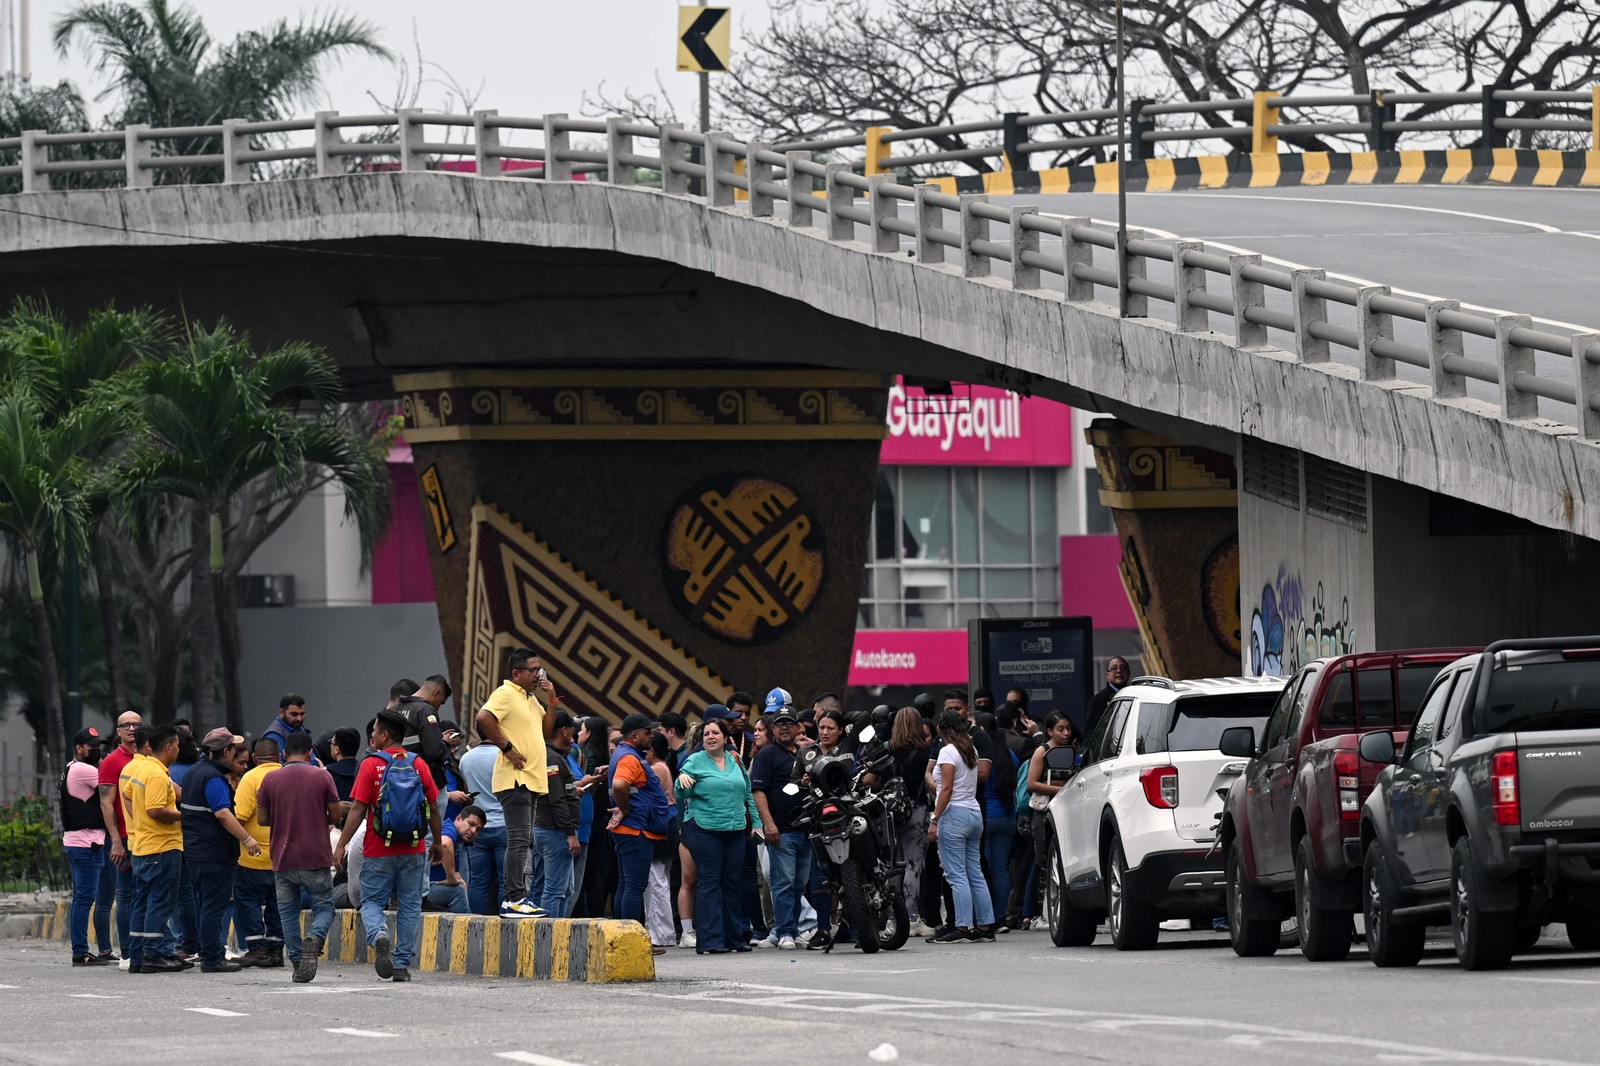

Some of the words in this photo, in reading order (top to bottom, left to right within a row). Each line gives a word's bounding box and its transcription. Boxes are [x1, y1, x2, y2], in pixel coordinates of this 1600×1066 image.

[886, 385, 1020, 452] Guayaquil
[1022, 638, 1052, 653] CeraVe
[855, 648, 917, 669] Autobanco
[1001, 663, 1040, 673] HIDRATACIÓN
[1041, 662, 1073, 671] CORPORAL
[1014, 675, 1030, 683] PARA
[1031, 674, 1044, 682] PIEL
[1045, 673, 1061, 682] SECA
[1529, 819, 1574, 828] ambacar
